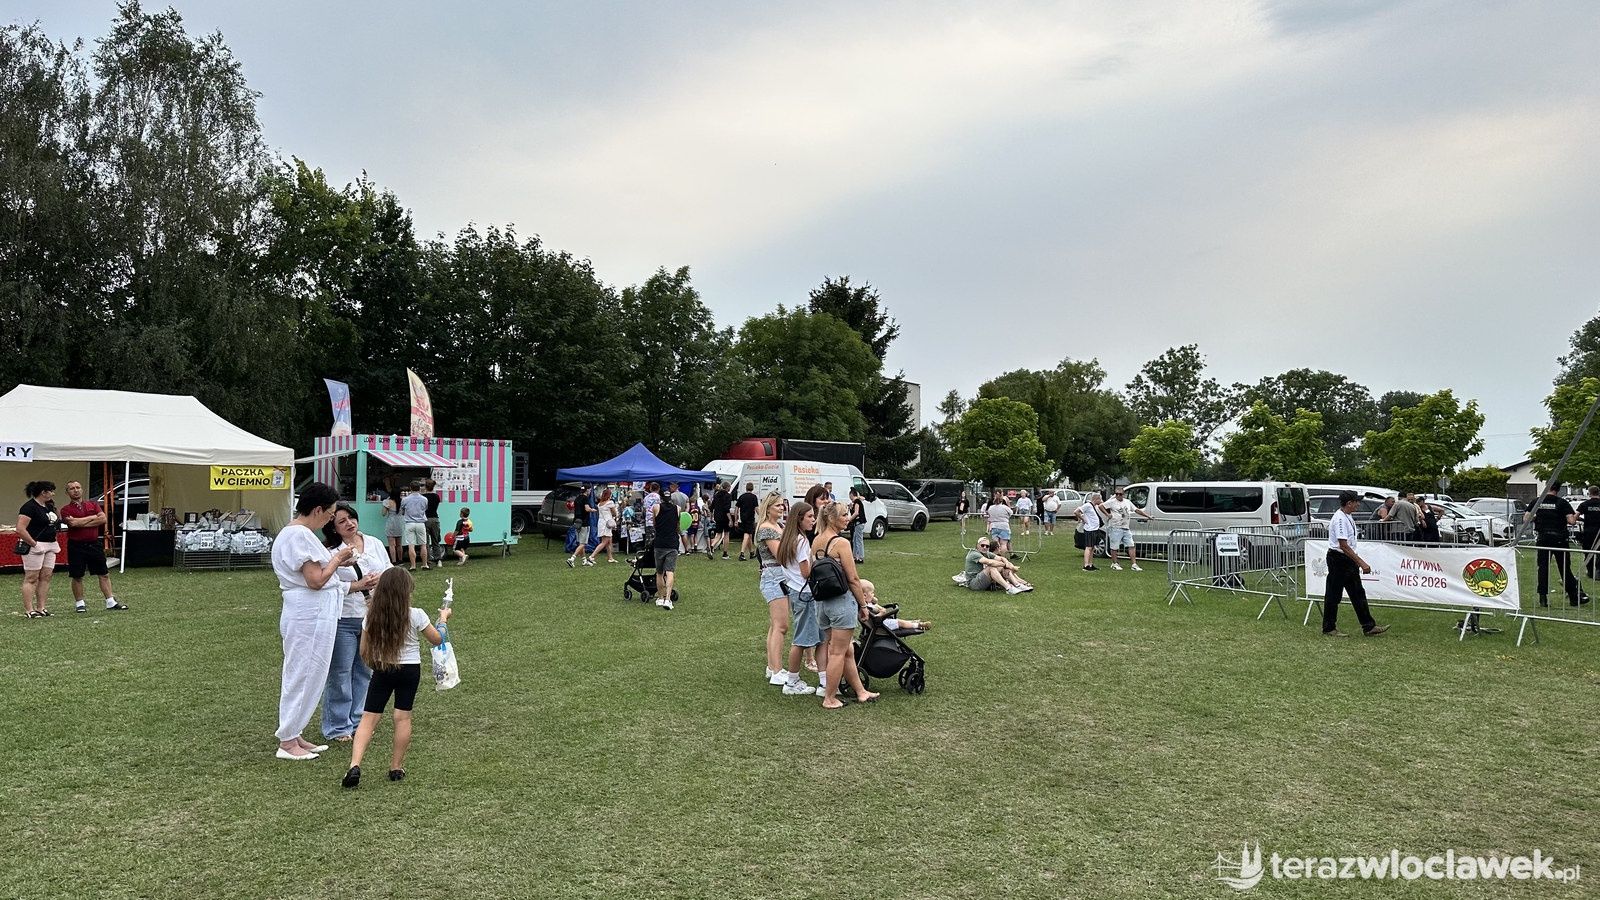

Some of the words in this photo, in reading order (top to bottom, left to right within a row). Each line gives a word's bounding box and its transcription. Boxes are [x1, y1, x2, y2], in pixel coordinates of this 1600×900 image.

[0, 446, 32, 458] RY
[221, 468, 264, 476] PACZKA
[793, 465, 820, 474] Pasieka
[214, 478, 225, 486] W
[227, 478, 270, 486] CIEMNO
[762, 476, 778, 484] Miód
[1400, 559, 1443, 572] AKTYWNA
[1469, 560, 1498, 571] LZS
[1396, 574, 1419, 587] WIEŚ
[1421, 576, 1447, 588] 2026
